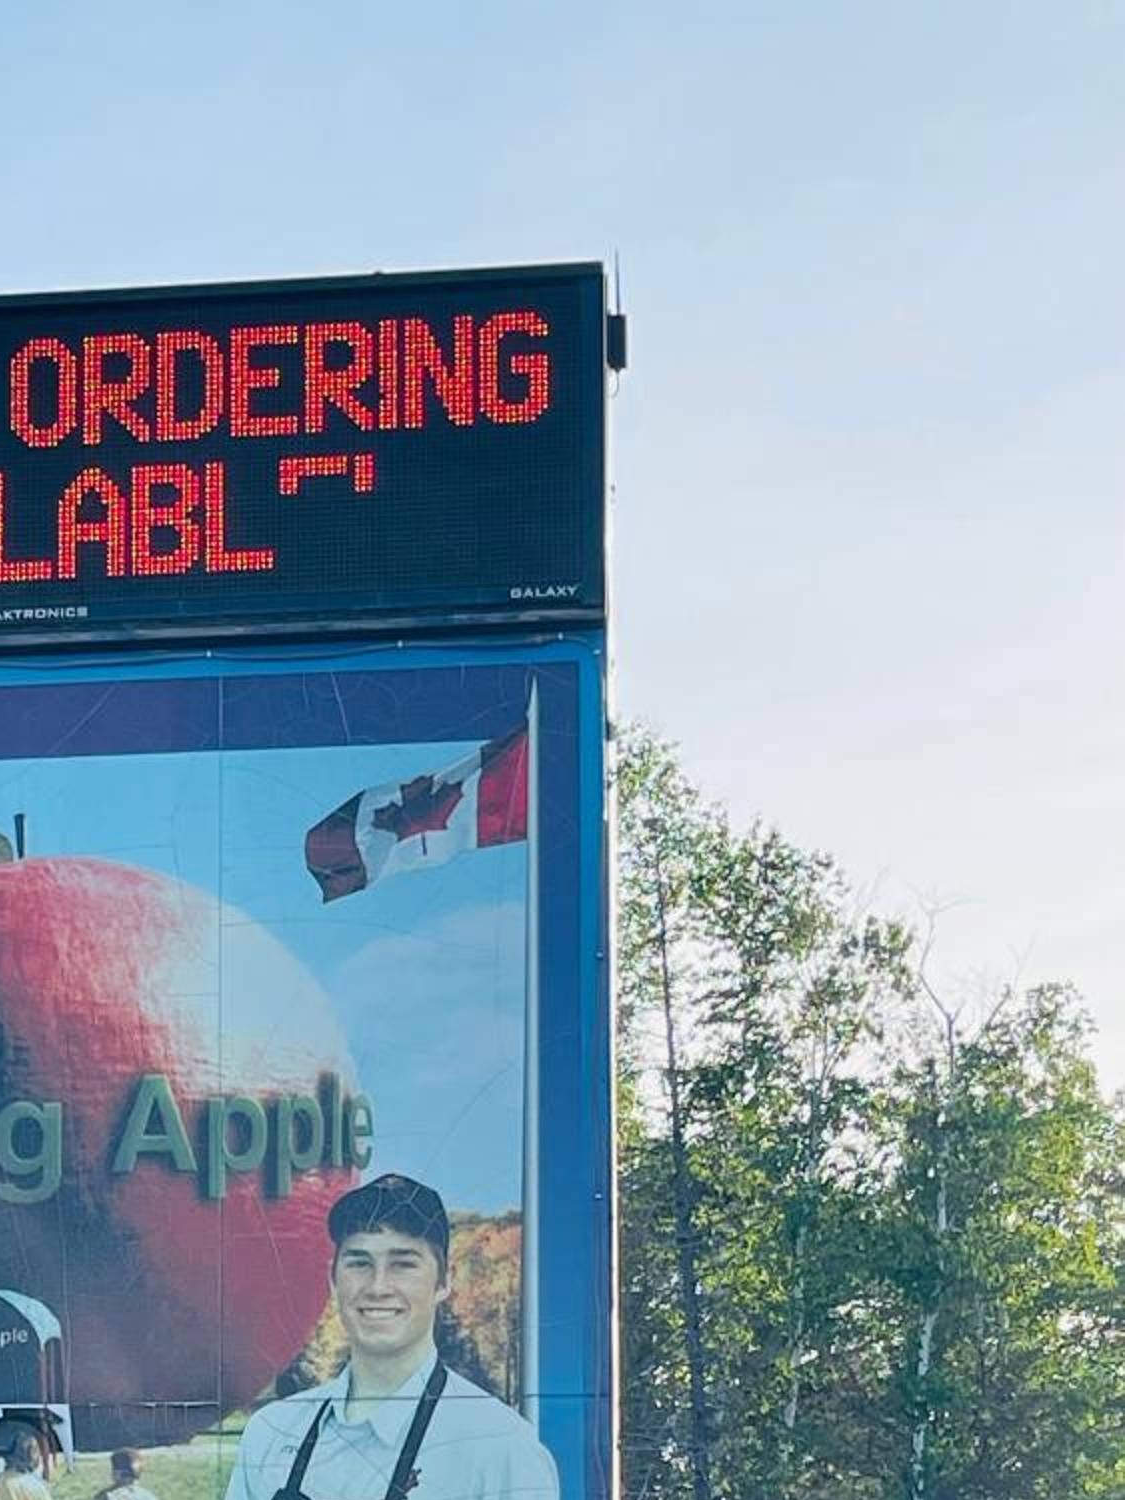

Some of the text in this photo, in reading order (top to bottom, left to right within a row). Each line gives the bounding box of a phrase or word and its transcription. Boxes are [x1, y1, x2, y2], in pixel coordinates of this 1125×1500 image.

[9, 310, 548, 448] ORDERING
[509, 585, 577, 599] GALAXY
[111, 1071, 375, 1199] Apple
